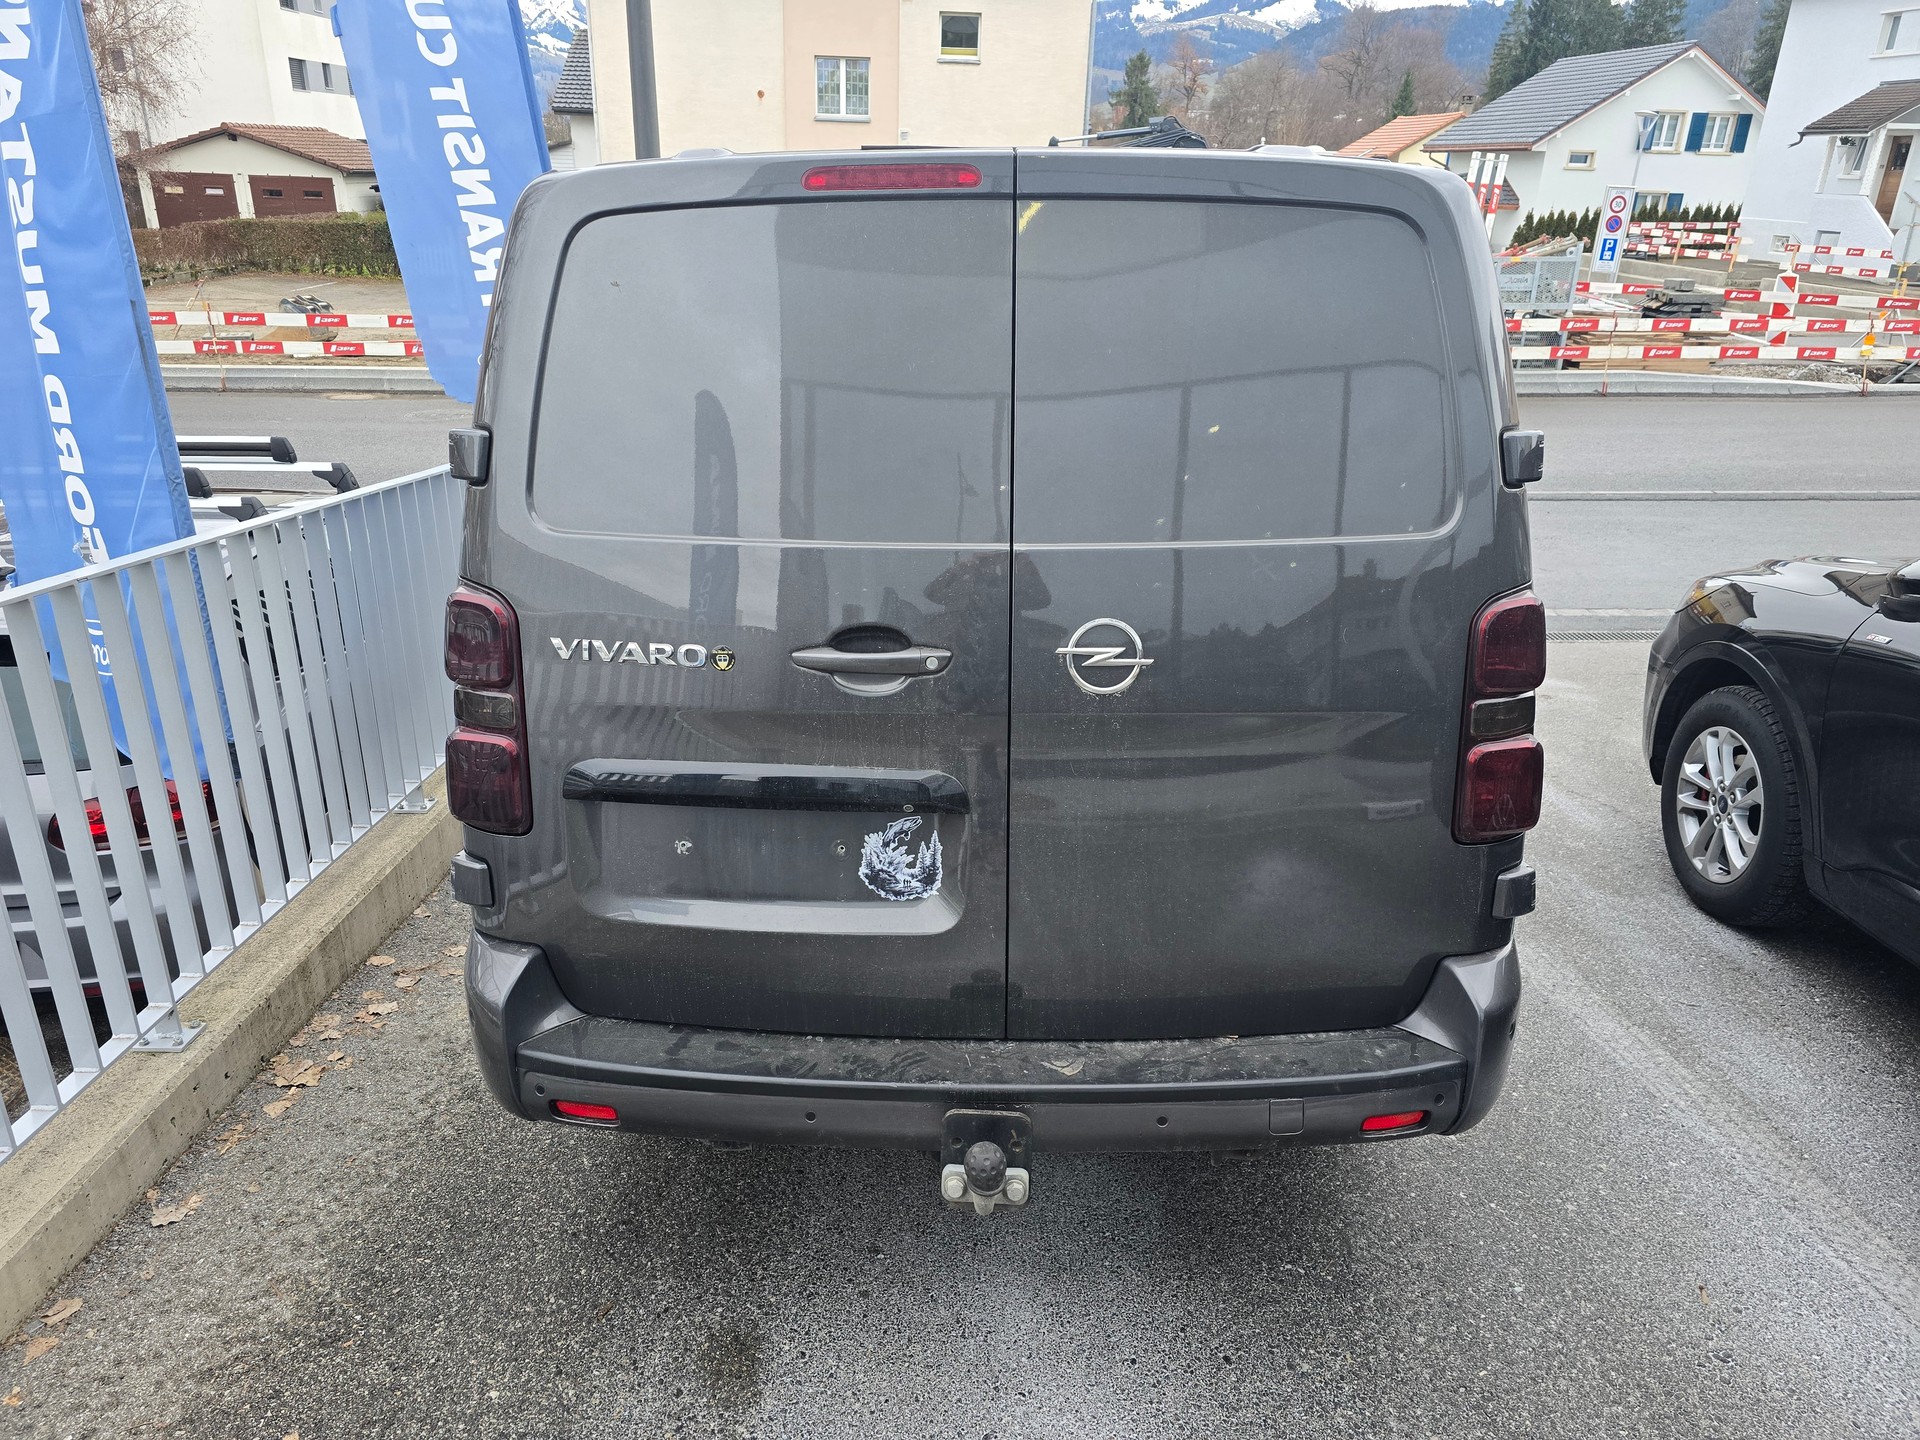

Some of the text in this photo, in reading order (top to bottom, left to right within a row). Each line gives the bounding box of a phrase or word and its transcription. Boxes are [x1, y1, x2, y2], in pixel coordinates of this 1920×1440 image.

[1614, 201, 1622, 209] 30
[1605, 240, 1614, 251] P
[550, 637, 708, 668] VIVARO
